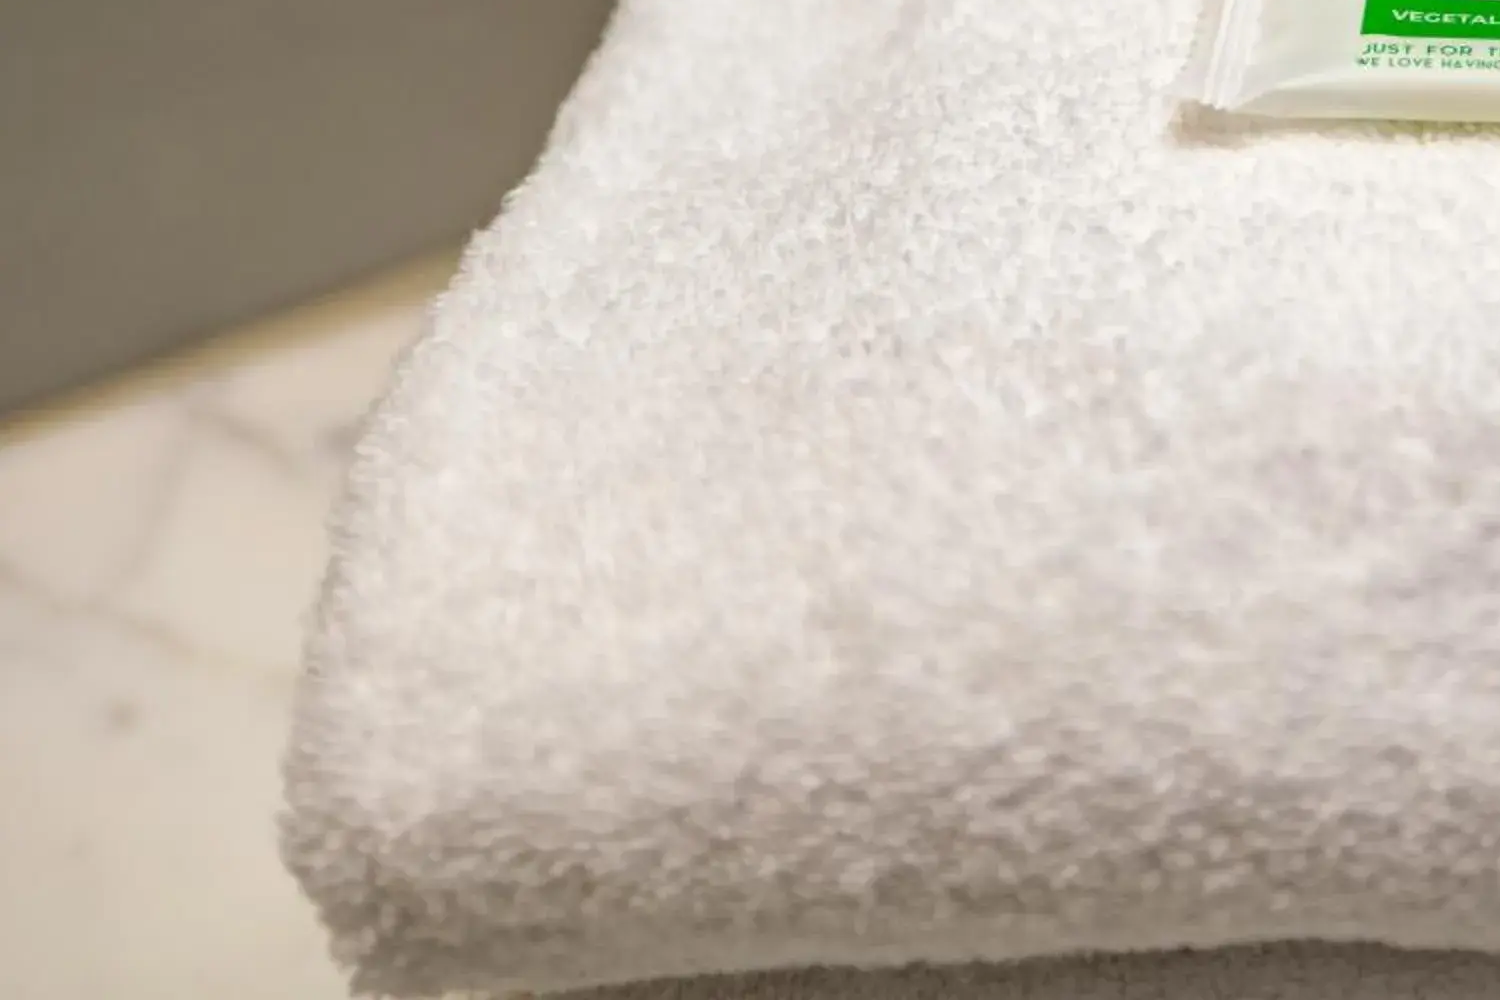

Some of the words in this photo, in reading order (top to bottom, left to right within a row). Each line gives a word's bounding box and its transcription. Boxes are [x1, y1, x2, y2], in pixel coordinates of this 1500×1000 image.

[1392, 9, 1500, 25] VEGETAL
[1363, 43, 1414, 56] JUST
[1426, 45, 1473, 57] FOR
[1355, 57, 1380, 68] WE
[1388, 57, 1432, 69] LOVE
